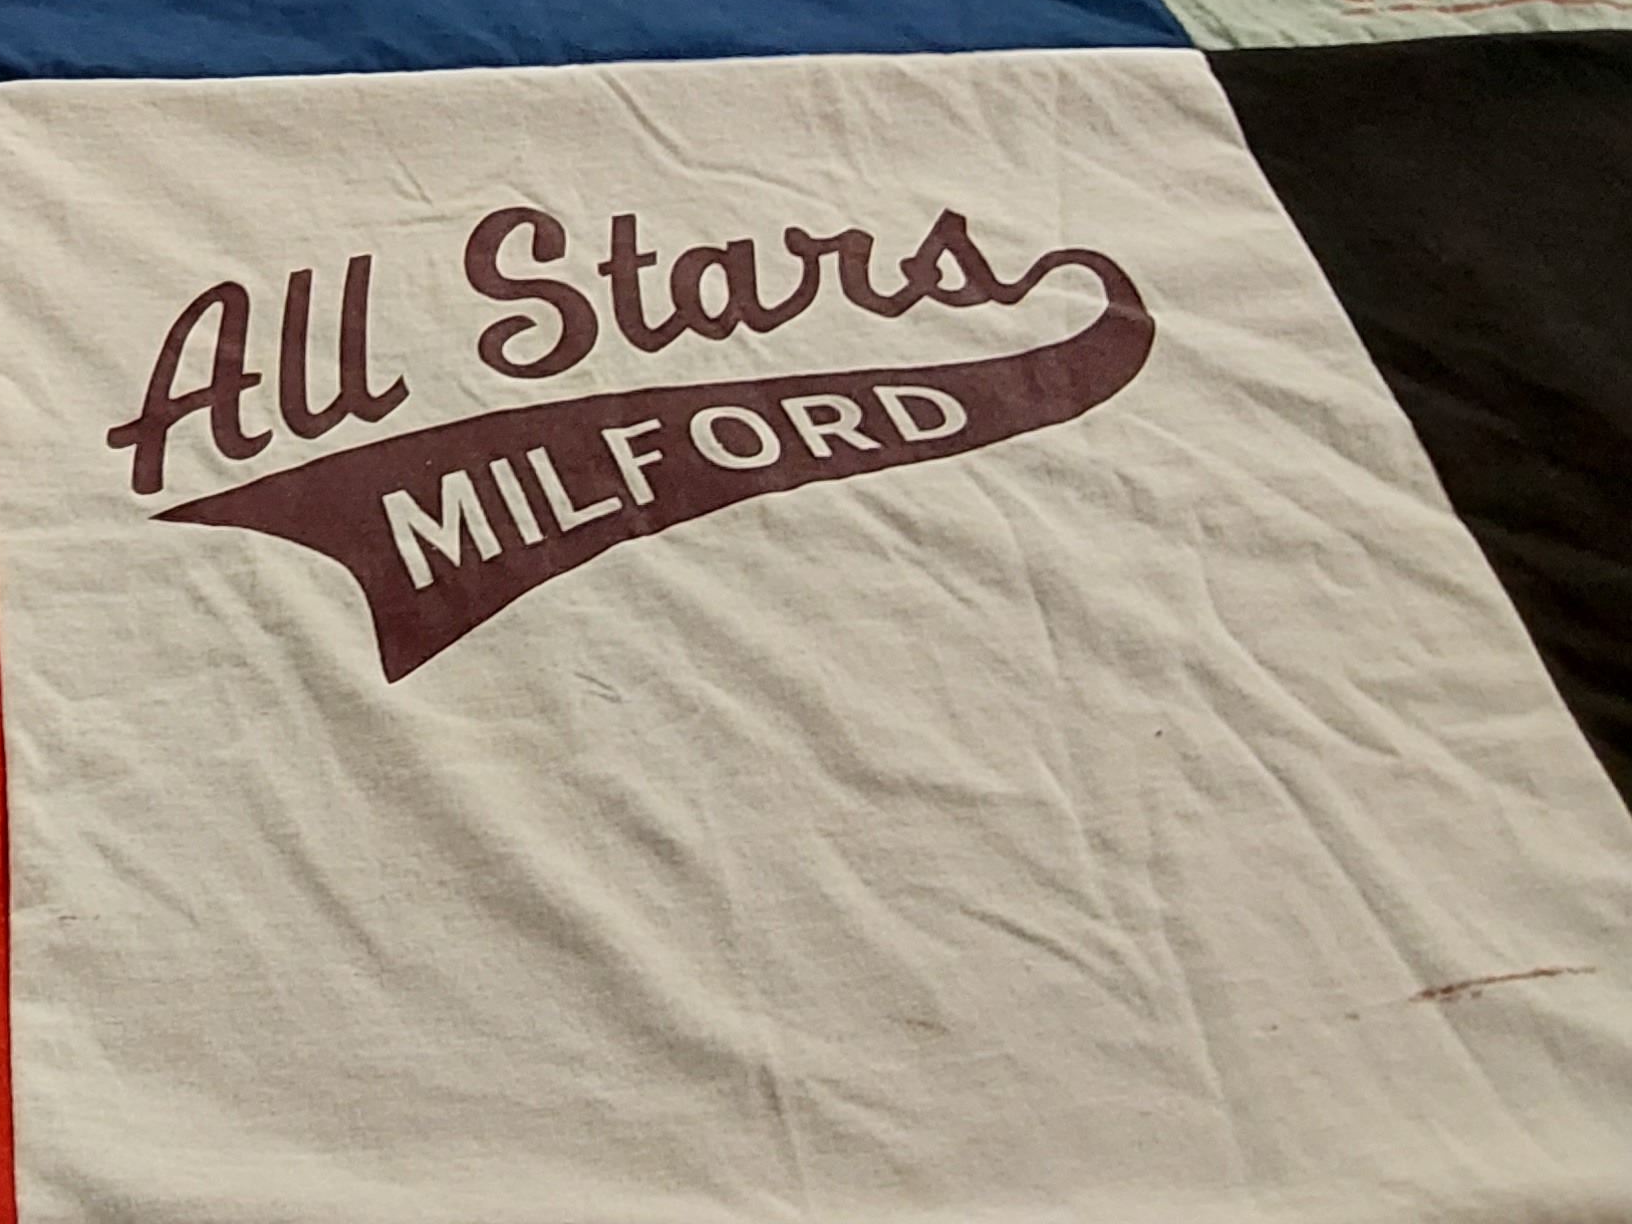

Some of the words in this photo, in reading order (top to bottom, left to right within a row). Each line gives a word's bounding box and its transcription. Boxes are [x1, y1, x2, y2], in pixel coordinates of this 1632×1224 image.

[106, 254, 410, 495] All
[464, 207, 1013, 378] Stars
[381, 384, 968, 589] MILFORD
